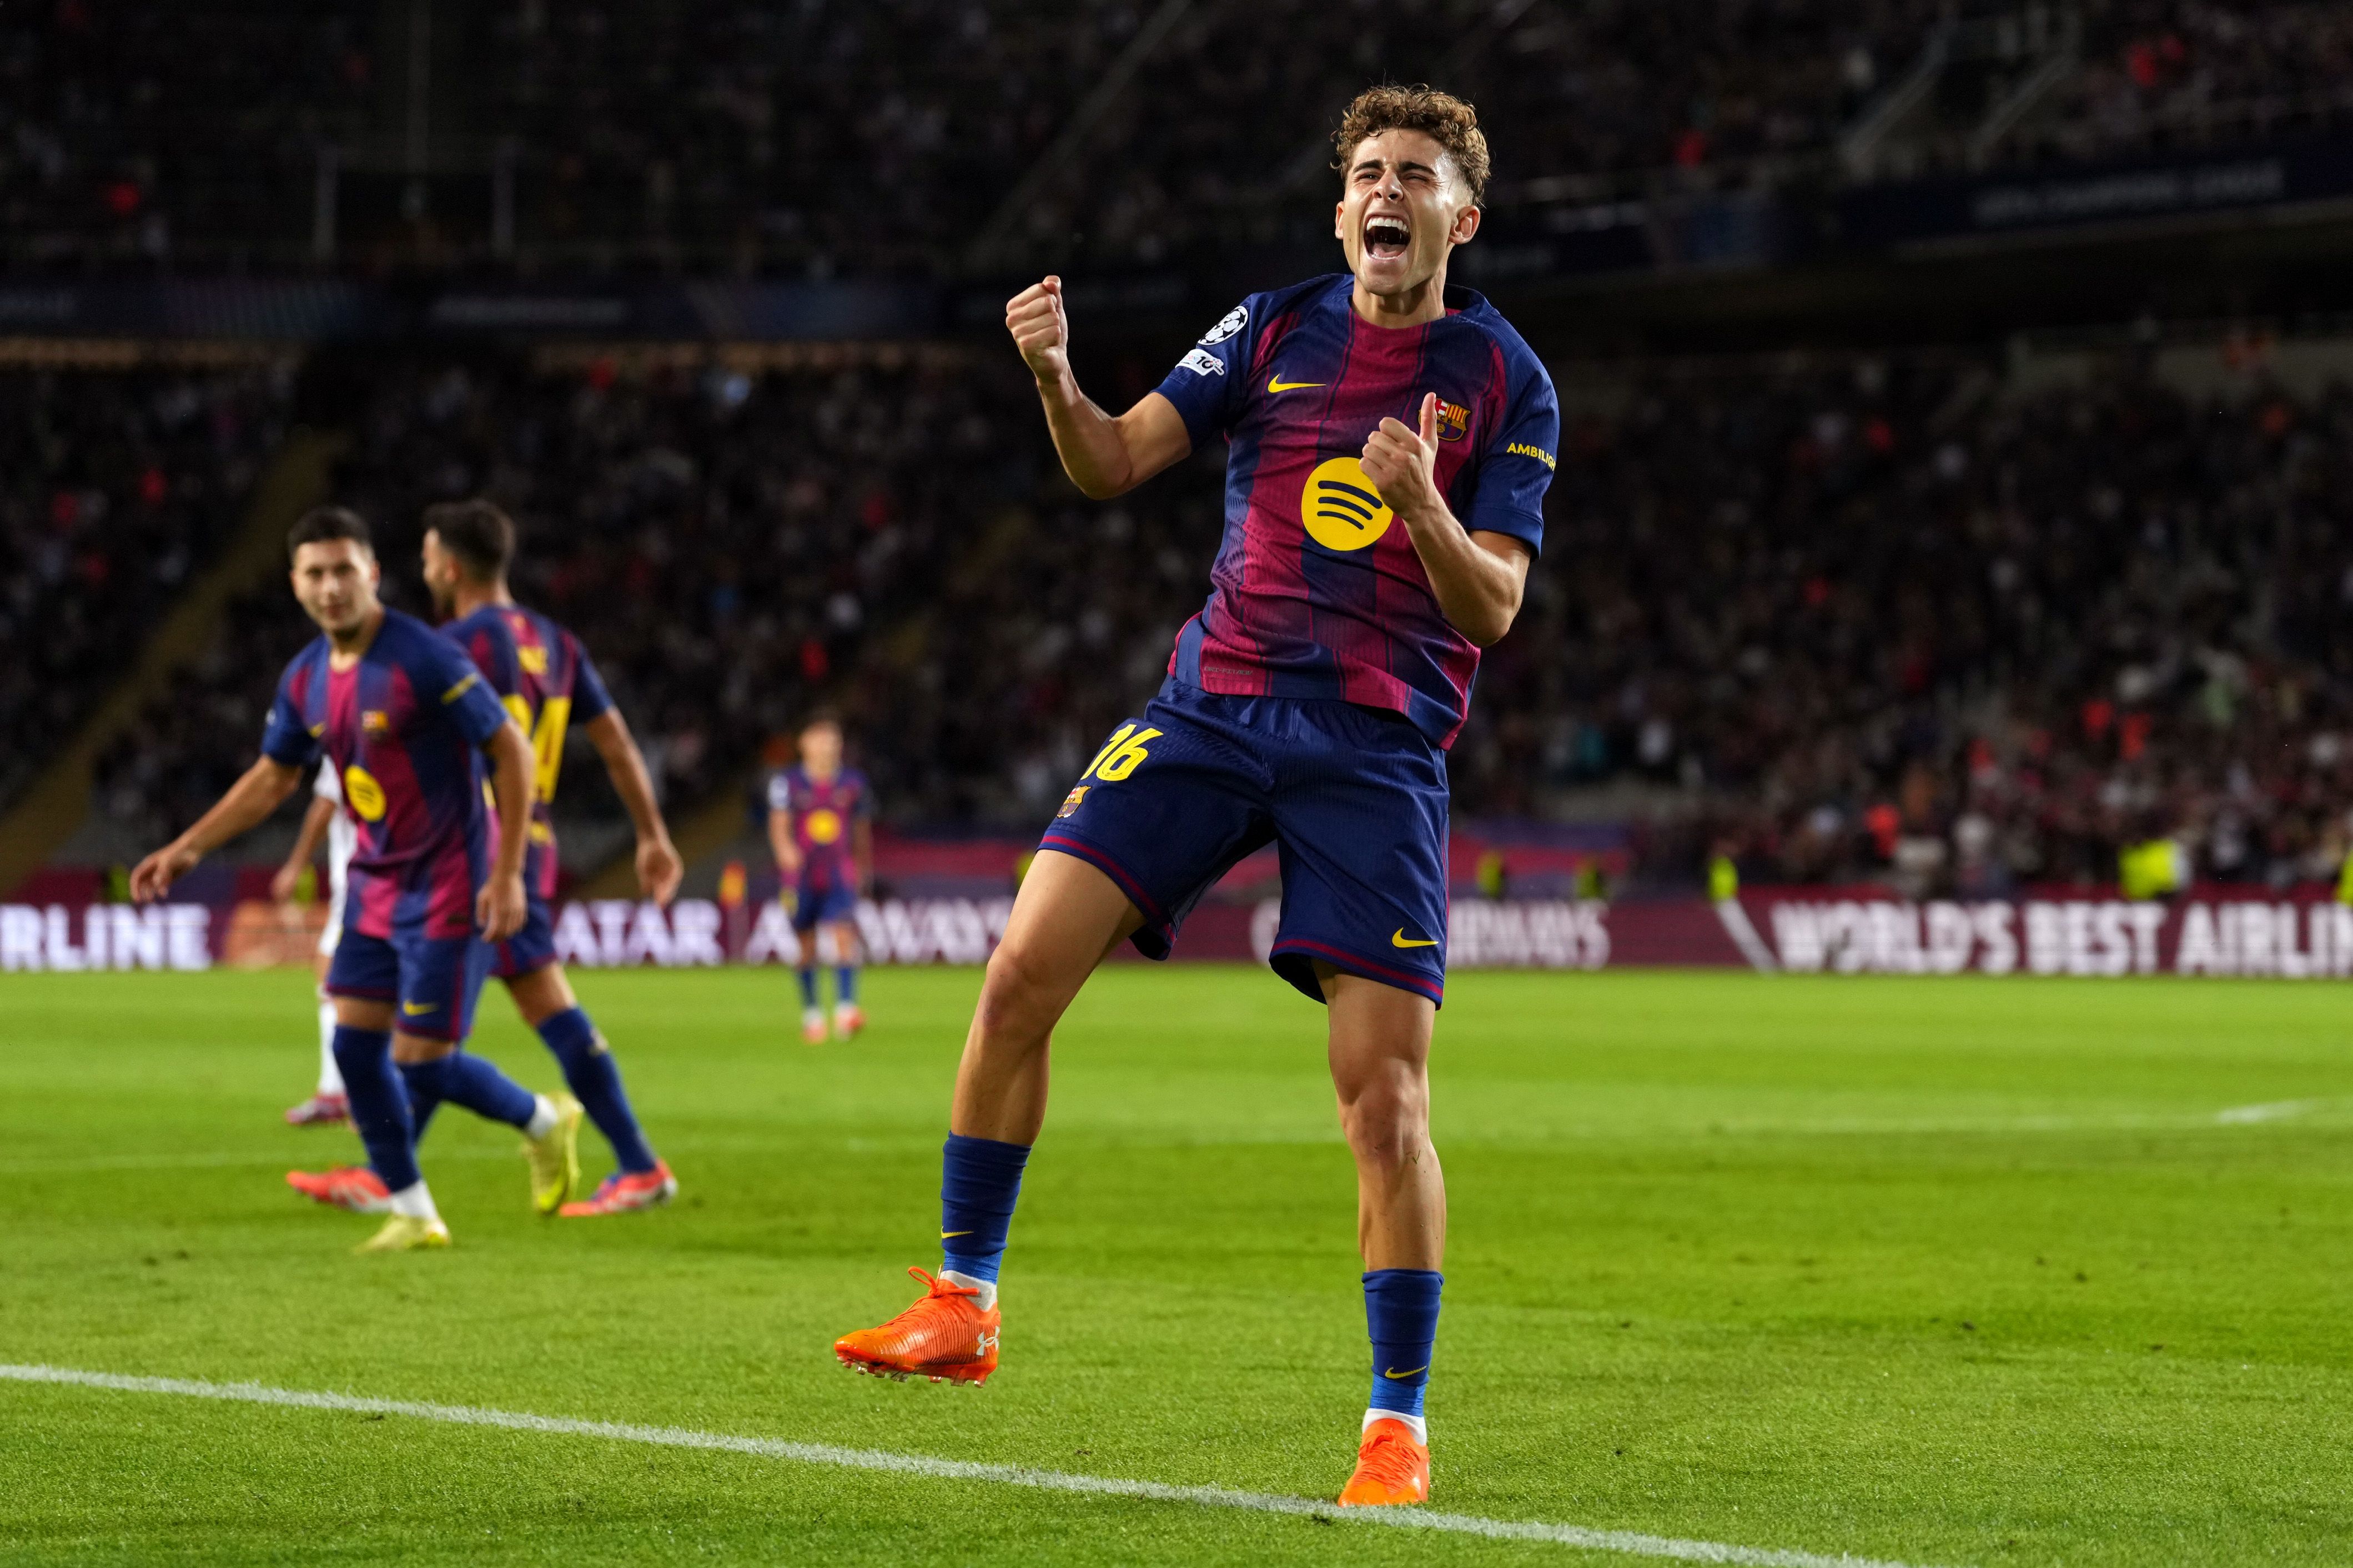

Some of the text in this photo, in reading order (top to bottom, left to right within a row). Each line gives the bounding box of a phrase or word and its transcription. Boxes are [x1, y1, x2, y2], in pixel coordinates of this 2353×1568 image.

[1080, 724, 1164, 781] 16
[552, 898, 723, 967] ATAR
[2024, 900, 2166, 976] BEST
